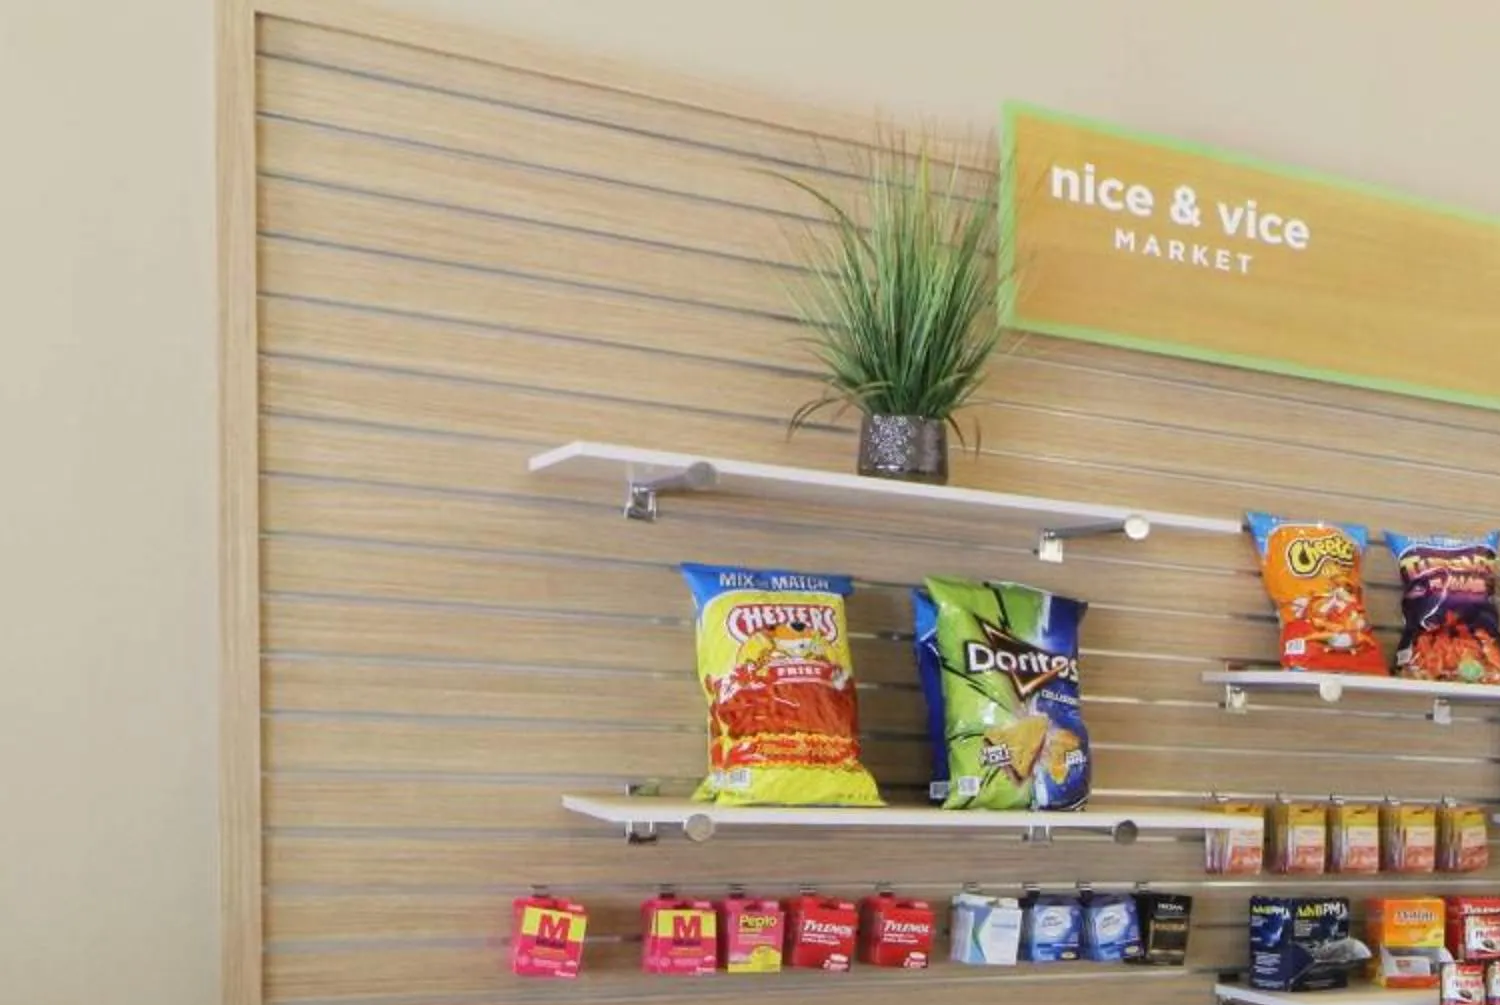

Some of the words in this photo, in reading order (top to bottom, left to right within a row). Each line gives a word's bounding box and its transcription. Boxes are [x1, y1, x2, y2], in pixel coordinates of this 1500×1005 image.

[1051, 164, 1154, 217] nice
[1169, 186, 1201, 228] &
[1217, 200, 1310, 249] vice
[1115, 228, 1254, 275] MARKET
[1290, 536, 1353, 573] Cheeto
[720, 572, 754, 587] MIX
[771, 575, 829, 590] MATCH
[728, 605, 837, 642] CHESTER'S
[967, 642, 1079, 682] Doritos
[739, 914, 777, 929] Pepto
[803, 919, 853, 937] TYLENOL
[883, 919, 929, 934] TYLENOL
